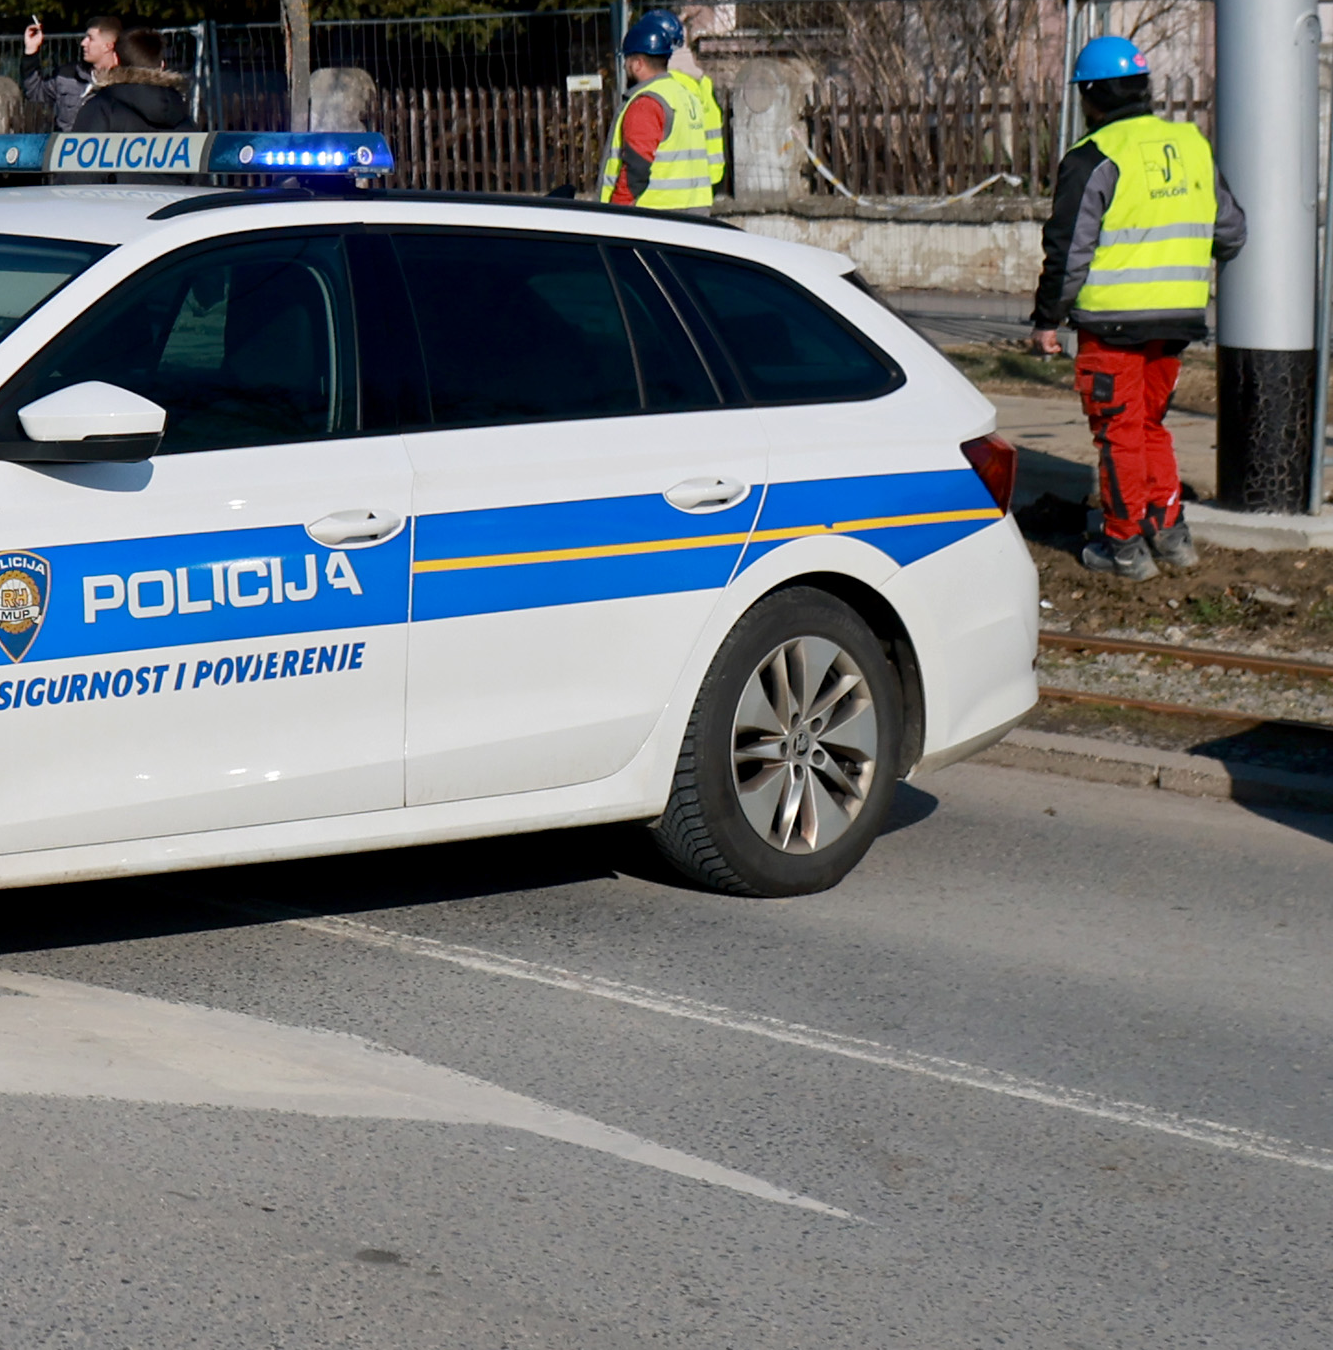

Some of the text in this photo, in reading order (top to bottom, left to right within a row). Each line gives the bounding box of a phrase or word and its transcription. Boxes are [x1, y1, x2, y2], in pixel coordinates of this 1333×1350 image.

[58, 137, 191, 169] POLICIJA
[2, 587, 29, 608] RH
[83, 551, 364, 624] POLICIJA
[1, 609, 31, 620] MUP
[174, 662, 187, 691] I
[193, 642, 366, 689] POVJERENJE
